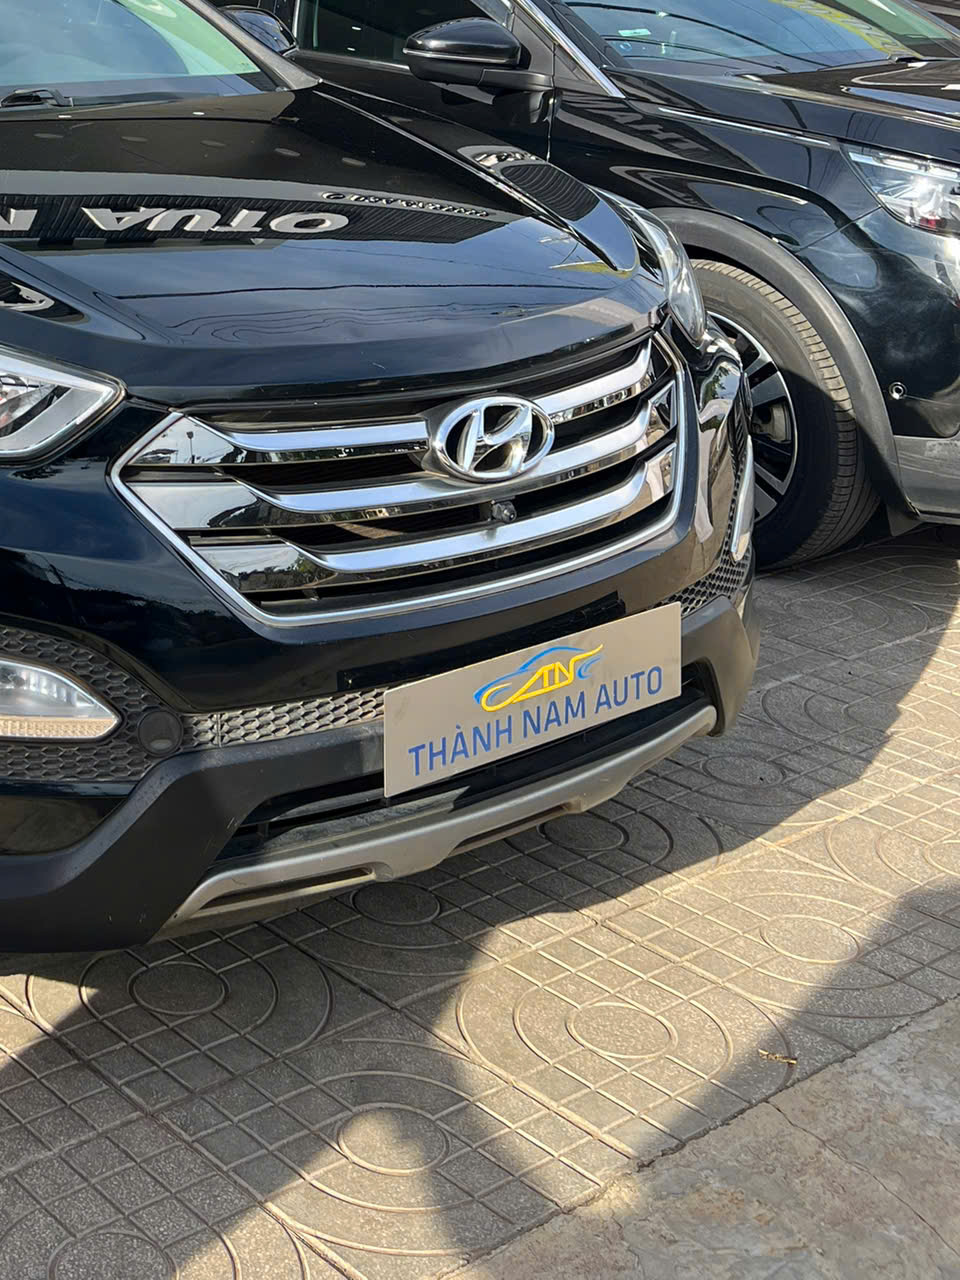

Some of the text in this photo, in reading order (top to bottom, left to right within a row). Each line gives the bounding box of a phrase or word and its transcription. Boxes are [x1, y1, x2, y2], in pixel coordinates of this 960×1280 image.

[408, 666, 663, 776] THÀNH NAM AUTO
